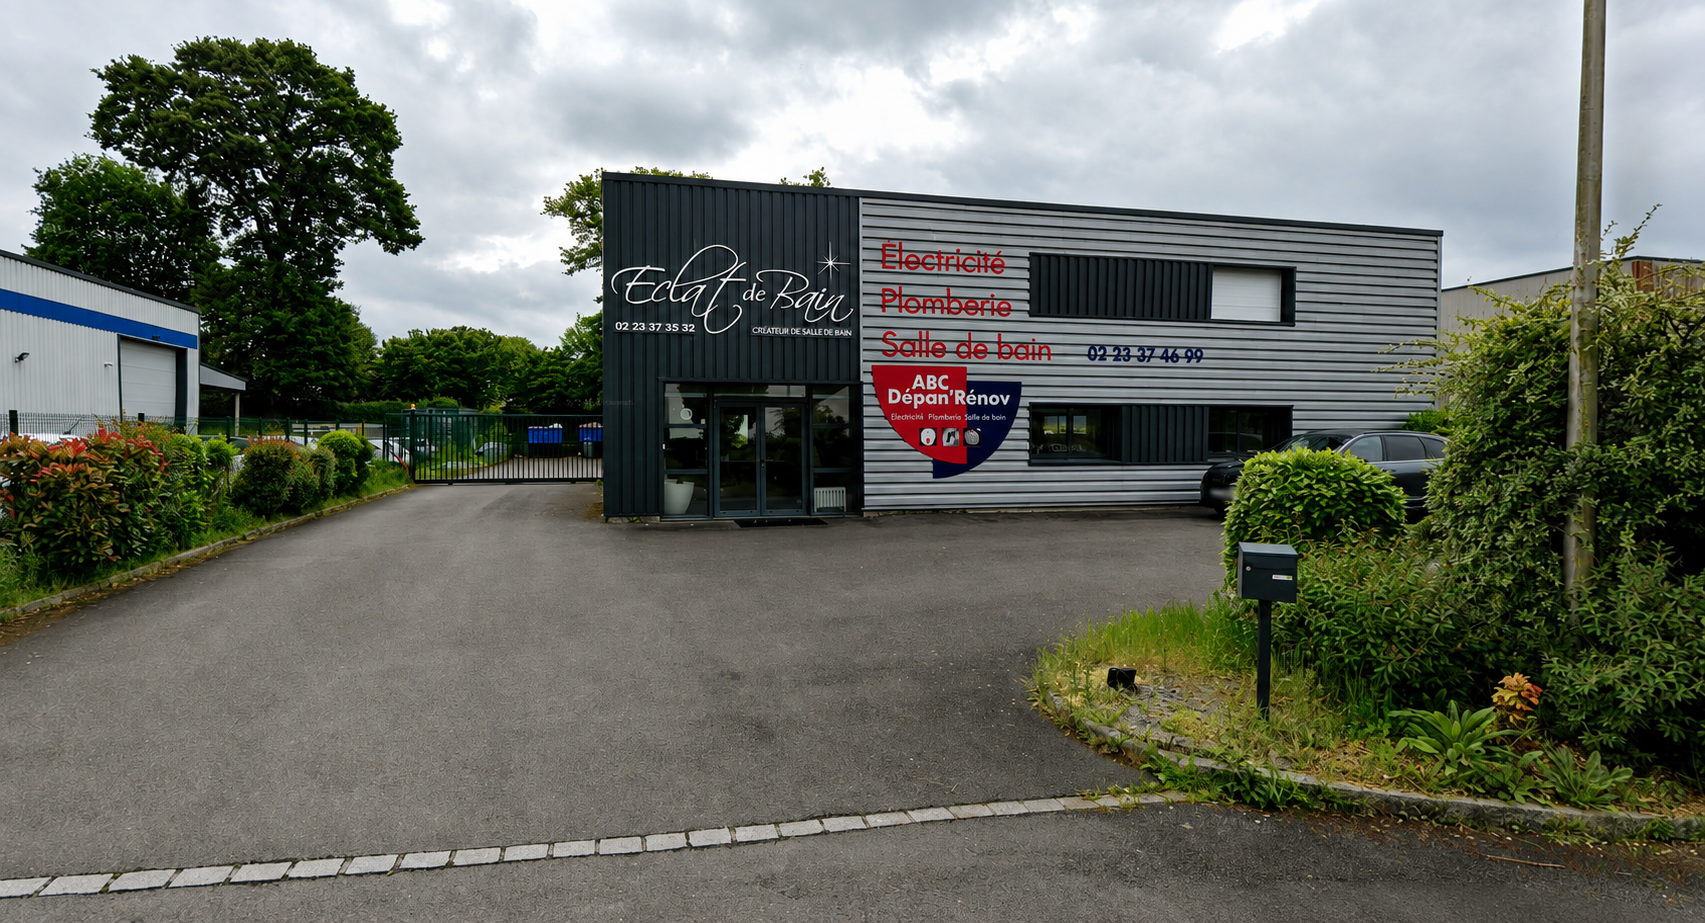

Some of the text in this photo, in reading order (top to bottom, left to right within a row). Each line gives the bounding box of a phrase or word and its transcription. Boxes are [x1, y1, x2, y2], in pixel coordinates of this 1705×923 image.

[881, 240, 1006, 274] Électricité
[611, 244, 854, 334] Eclat de Bain
[881, 286, 1012, 317] Plomberie
[615, 322, 695, 333] 02 23 37 35 32
[752, 326, 789, 335] CRÉATEUR
[882, 331, 1052, 361] Salle de bain
[1087, 346, 1204, 364] 02 23 37 46 99
[912, 374, 949, 390] ABC
[888, 388, 1010, 409] Dépan'Rénov
